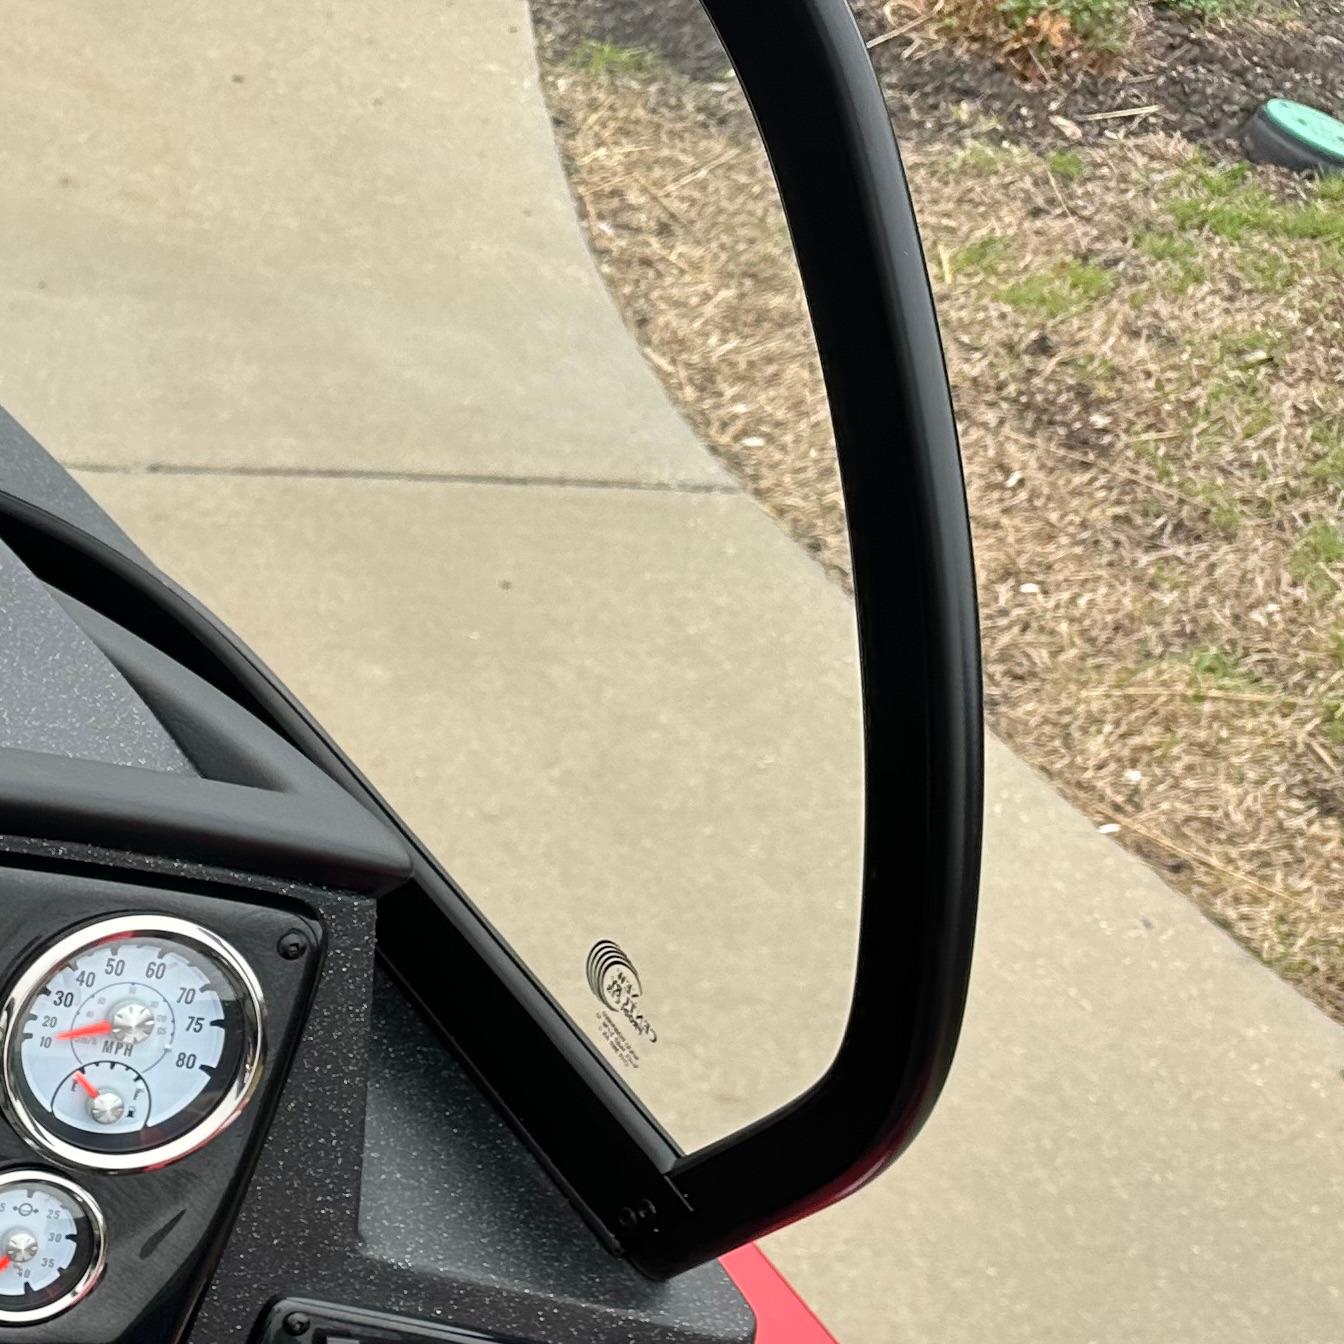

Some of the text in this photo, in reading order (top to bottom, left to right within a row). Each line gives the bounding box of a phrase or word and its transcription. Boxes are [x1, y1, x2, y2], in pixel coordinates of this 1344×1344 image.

[104, 958, 125, 977] 50
[145, 962, 167, 980] 60
[76, 970, 96, 988] 40
[53, 991, 74, 1008] 30
[176, 987, 195, 1005] 70
[42, 1015, 57, 1029] 20
[185, 1016, 203, 1033] 75
[39, 1036, 52, 1049] 10
[102, 1040, 134, 1057] MPH
[176, 1052, 196, 1070] 80
[47, 1209, 61, 1220] 25
